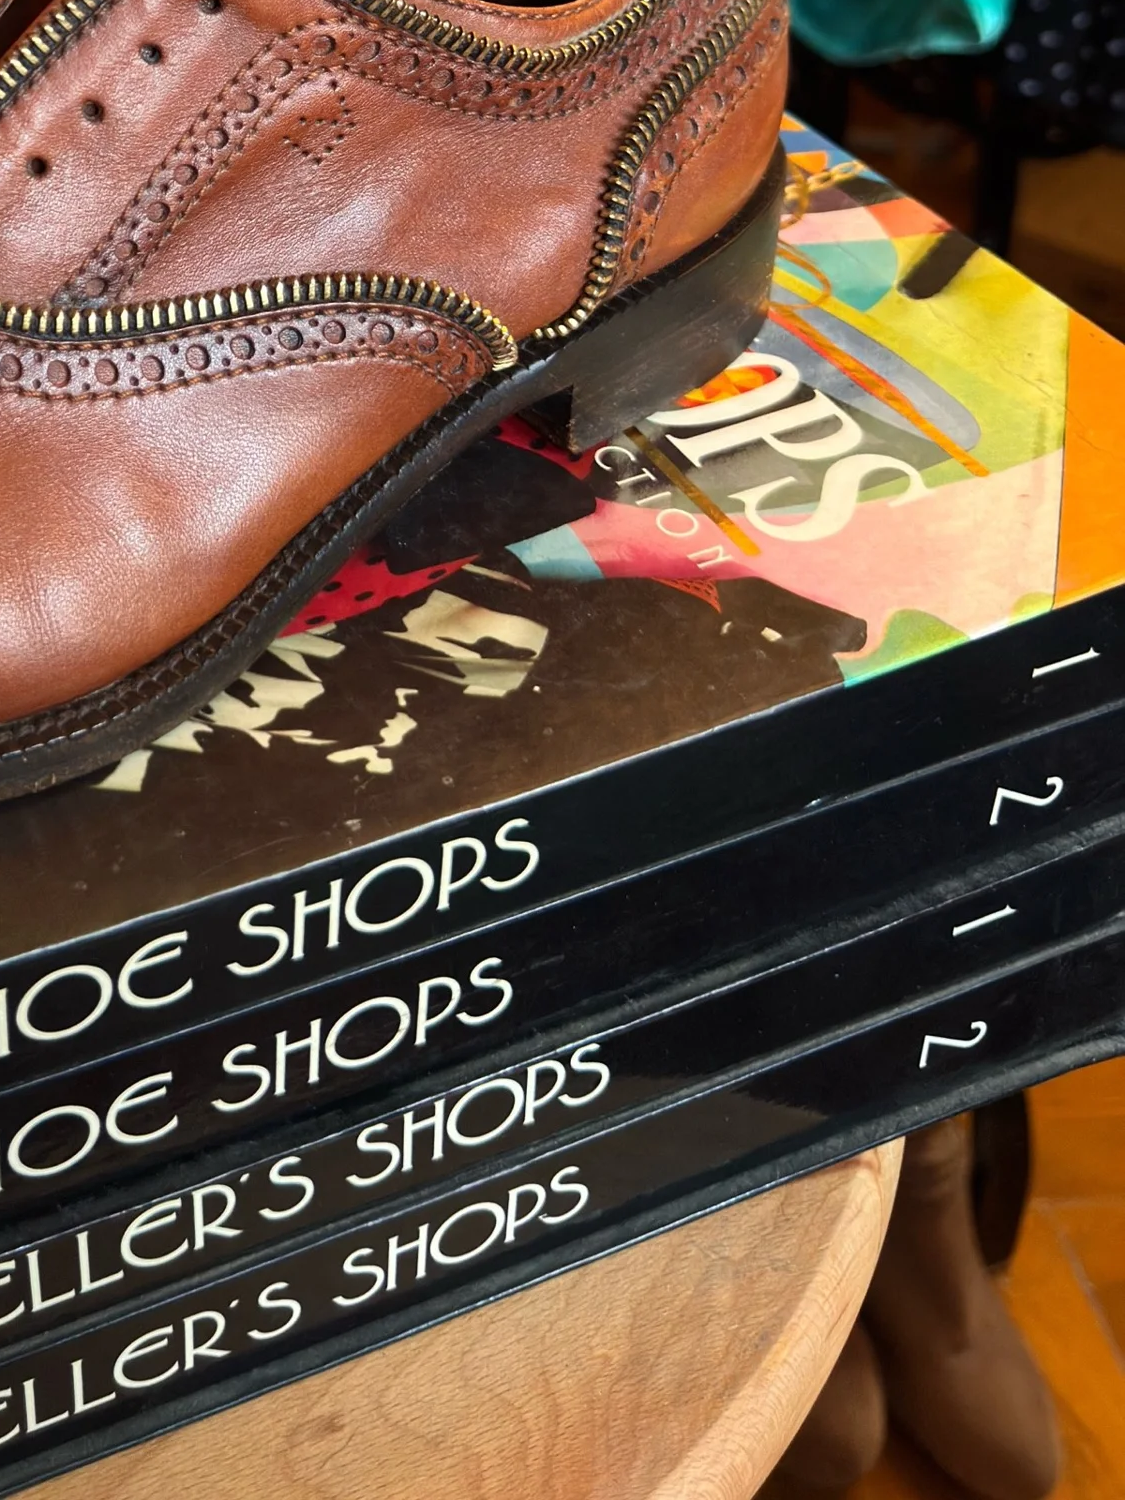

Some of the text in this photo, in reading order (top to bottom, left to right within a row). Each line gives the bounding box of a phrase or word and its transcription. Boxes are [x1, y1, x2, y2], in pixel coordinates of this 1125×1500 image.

[594, 444, 732, 569] CTION
[646, 352, 939, 542] OPS
[989, 776, 1064, 826] 2
[227, 817, 540, 976] SHOPS
[211, 956, 513, 1112] SHOPS
[918, 1020, 988, 1069] 2
[346, 1042, 610, 1187] SHOPS
[332, 1165, 590, 1307] SHOPS
